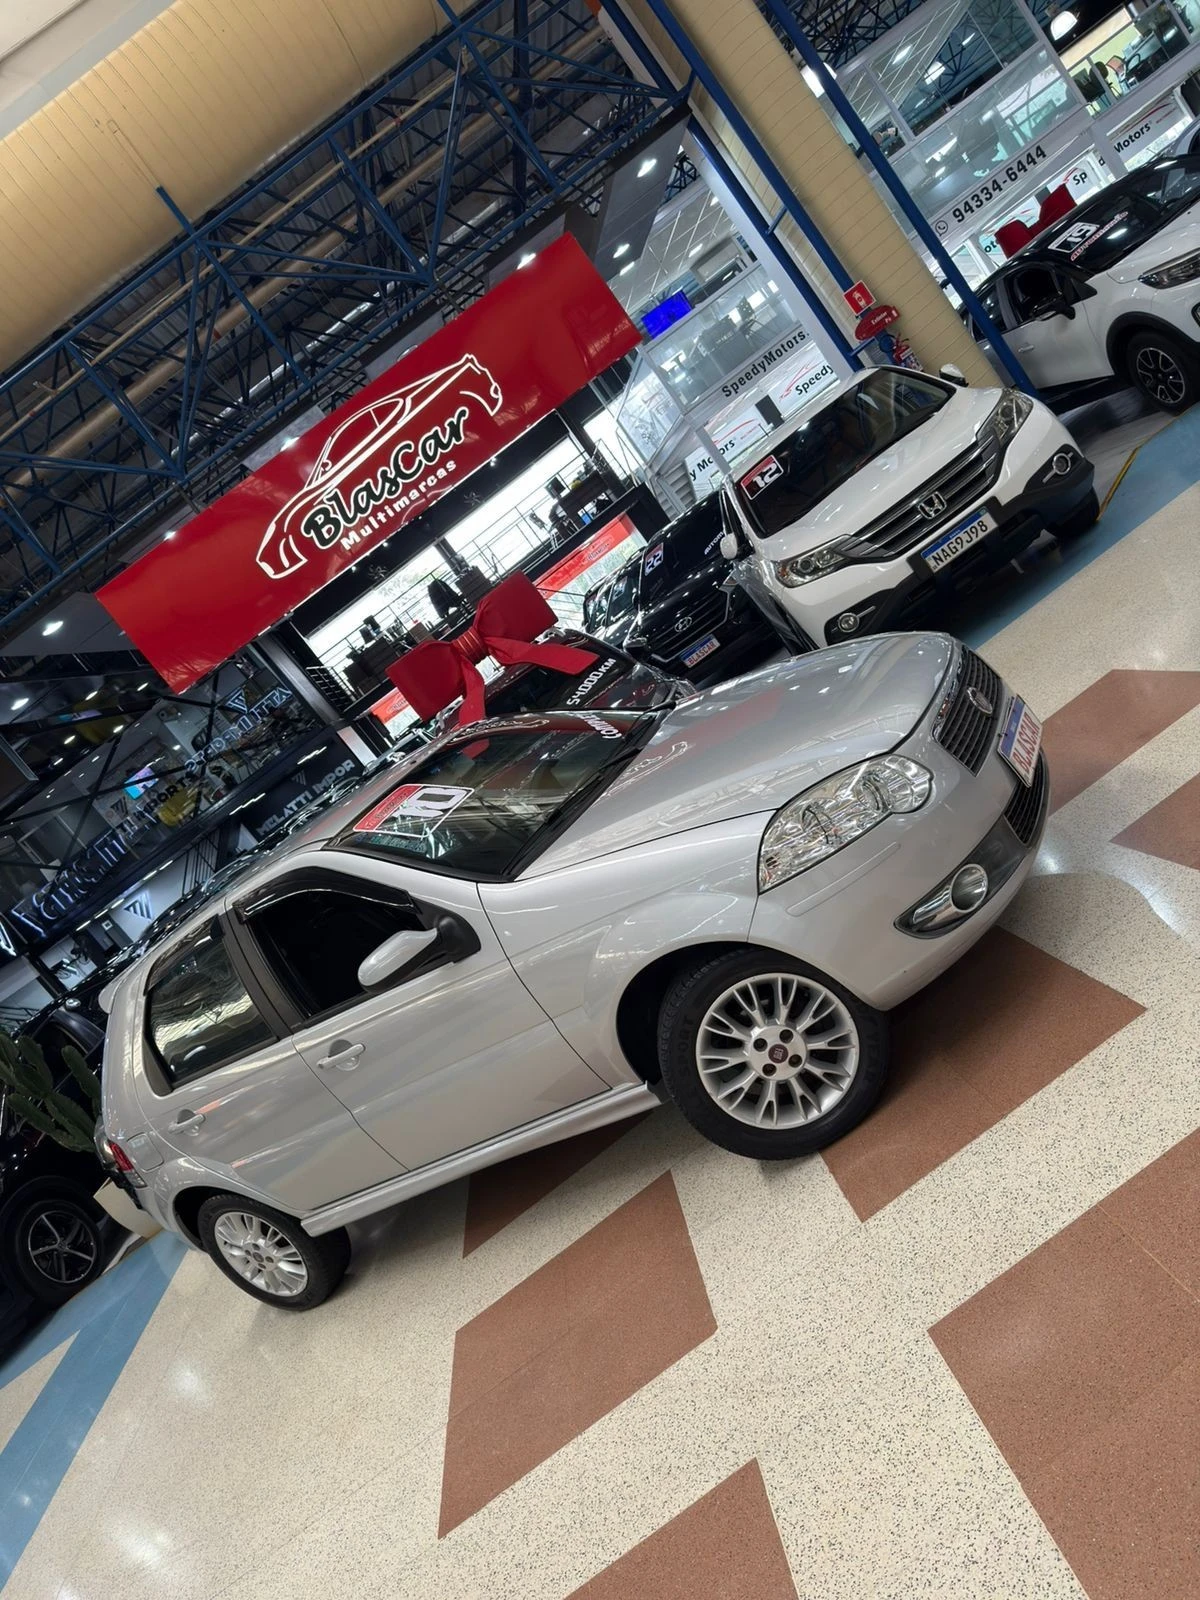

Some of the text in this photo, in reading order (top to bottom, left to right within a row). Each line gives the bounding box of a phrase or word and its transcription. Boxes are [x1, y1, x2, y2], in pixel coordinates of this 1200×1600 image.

[952, 145, 1047, 223] 94334-6444
[1065, 225, 1093, 243] 19
[795, 365, 834, 395] Speedy
[697, 439, 735, 472] Moors
[301, 406, 469, 549] BlasCar
[753, 462, 778, 488] 12
[340, 460, 456, 550] Multimarcas
[704, 531, 724, 555] AUTOM
[931, 520, 988, 566] NAG9J98
[645, 549, 664, 574] 22
[688, 641, 717, 665] BLASCAR
[1012, 711, 1041, 775] BLASCAR
[256, 758, 356, 837] MELATTI IMPOR
[391, 787, 468, 818] 10
